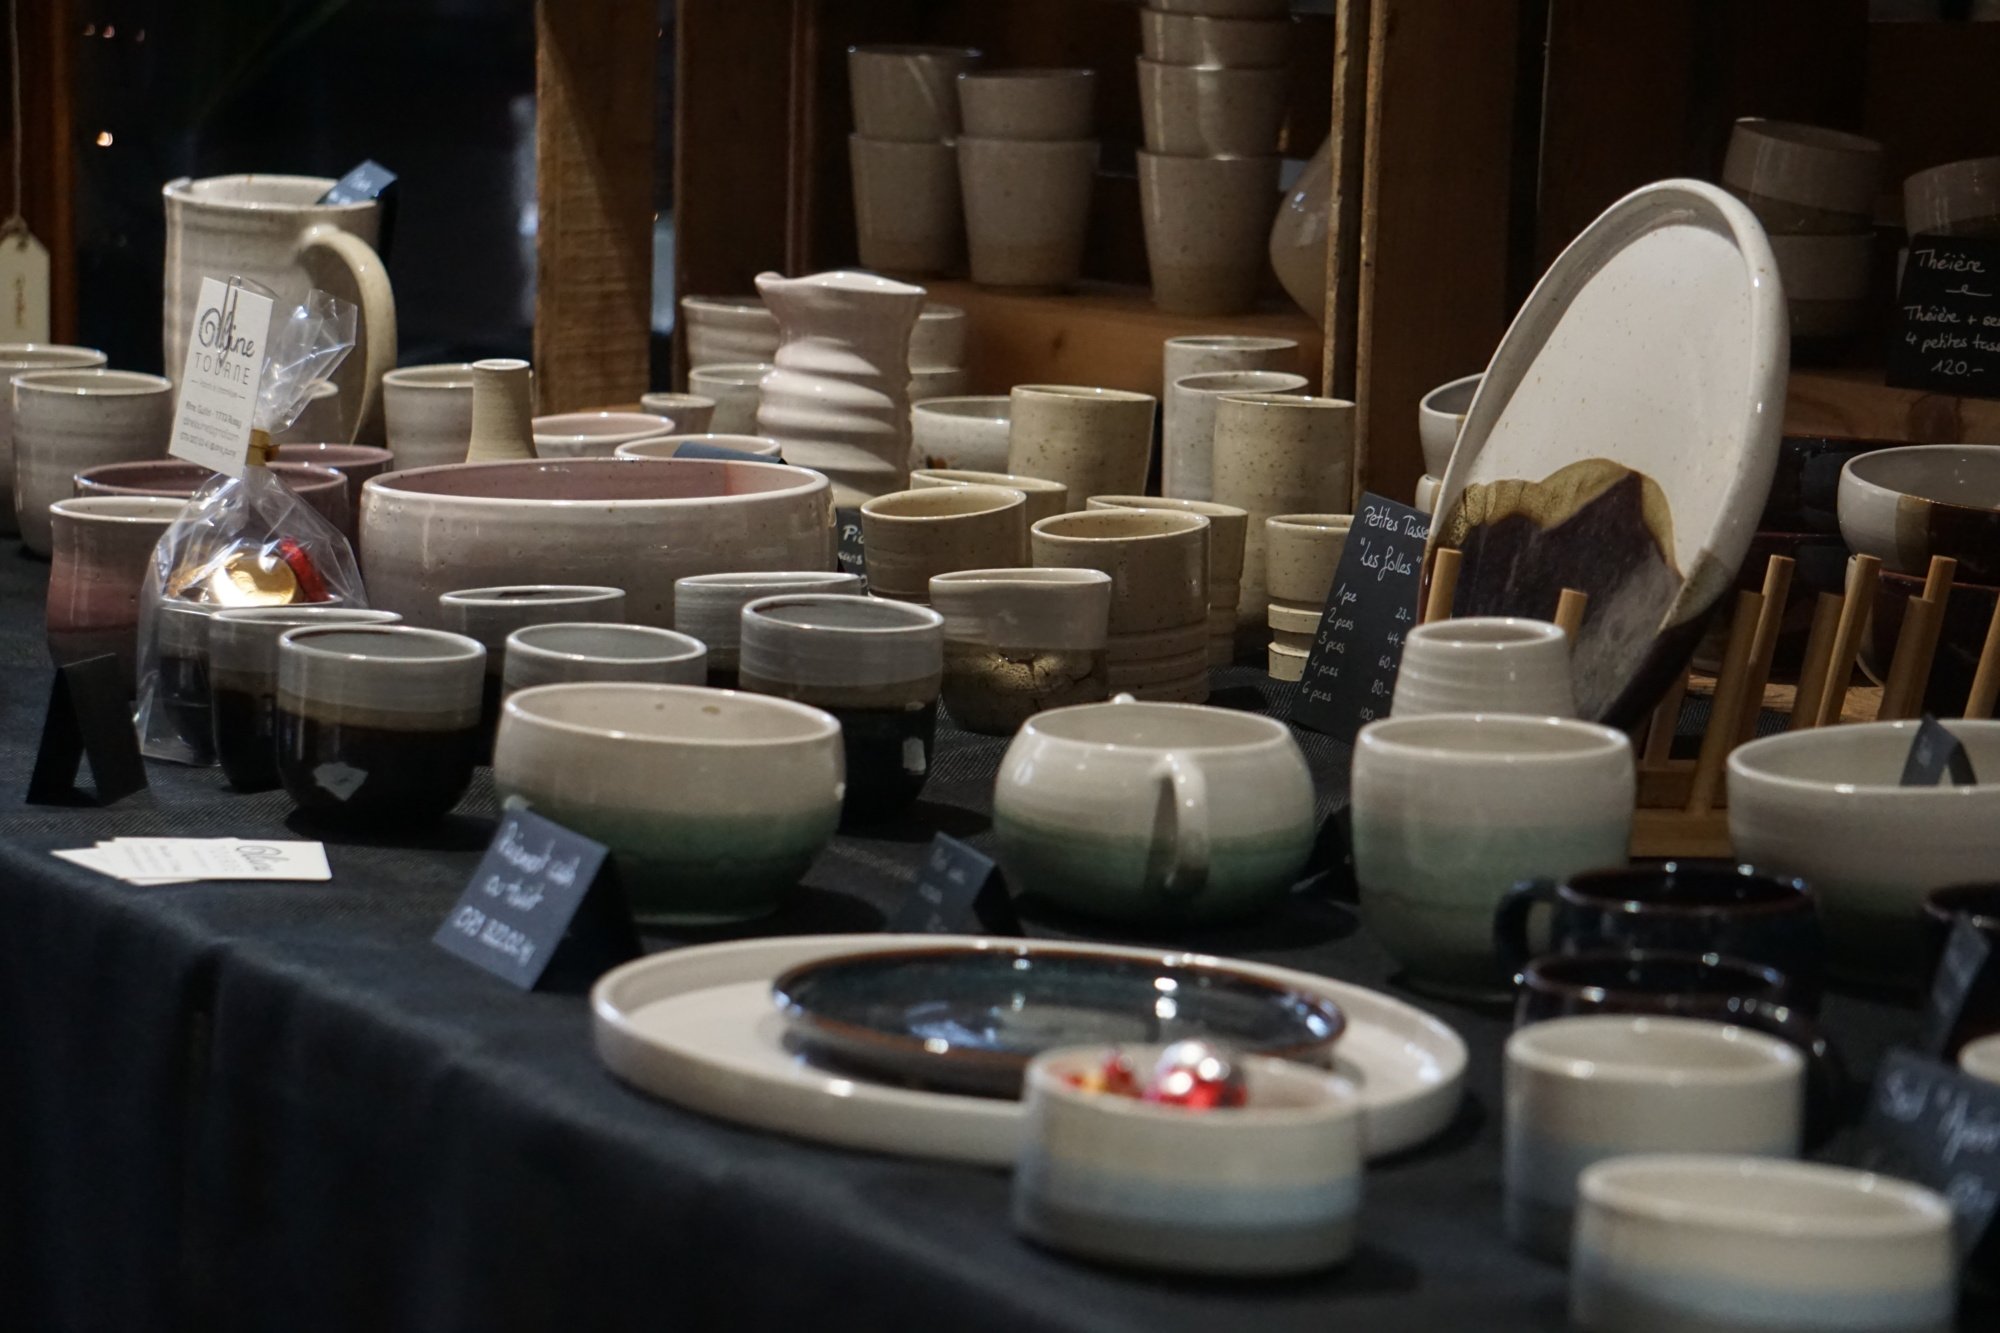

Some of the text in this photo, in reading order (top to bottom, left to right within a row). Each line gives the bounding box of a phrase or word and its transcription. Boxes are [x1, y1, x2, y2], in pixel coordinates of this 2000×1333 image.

[1915, 248, 1986, 273] Théière
[1982, 315, 2000, 327] se
[1905, 331, 1917, 345] 4
[1921, 332, 1968, 353] petites
[195, 352, 251, 386] TOURNE
[1930, 359, 1985, 377] 120.-
[1364, 505, 1430, 540] Petites Tasse
[842, 524, 865, 545] Pic
[1327, 608, 1336, 624] 2
[1318, 631, 1327, 645] 3
[1311, 656, 1319, 670] 4
